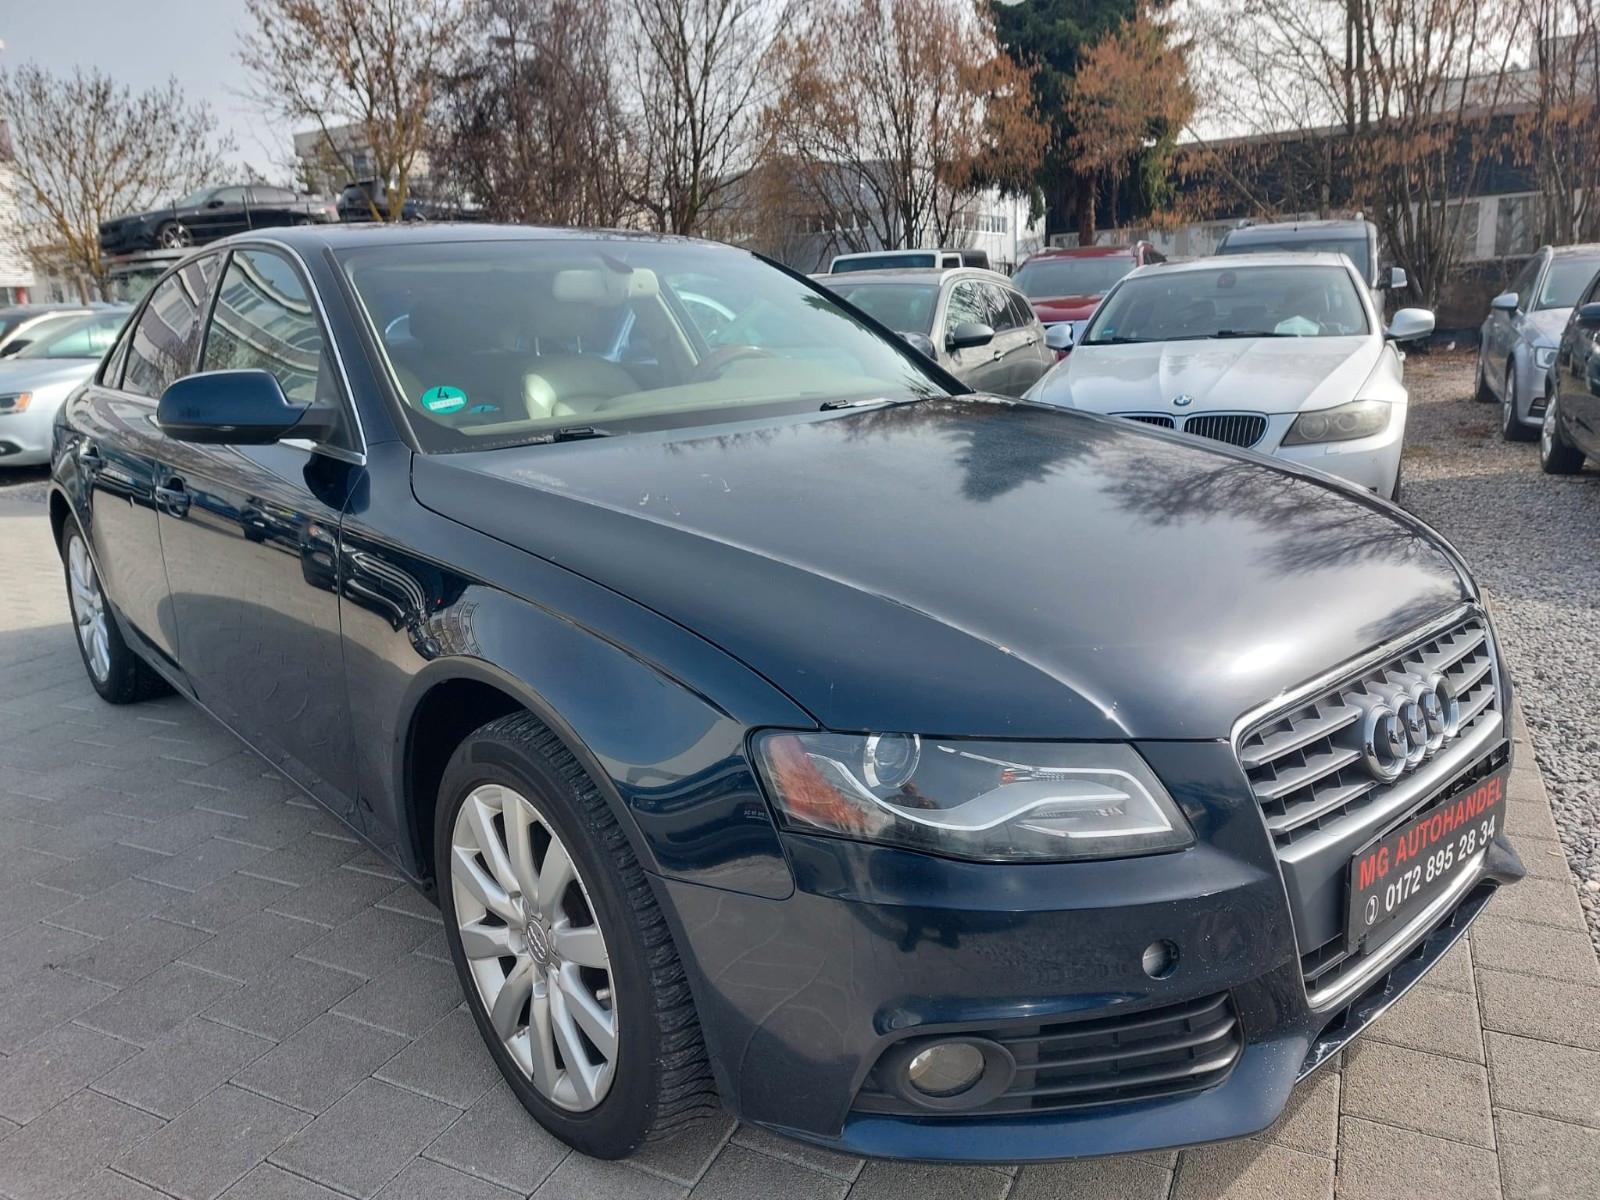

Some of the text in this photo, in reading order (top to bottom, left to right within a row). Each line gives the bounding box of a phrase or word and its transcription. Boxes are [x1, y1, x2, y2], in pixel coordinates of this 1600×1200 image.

[437, 387, 449, 399] 4
[1359, 777, 1502, 891] MG AUTOHANDEL
[1385, 814, 1496, 912] 0172 895 28 34
